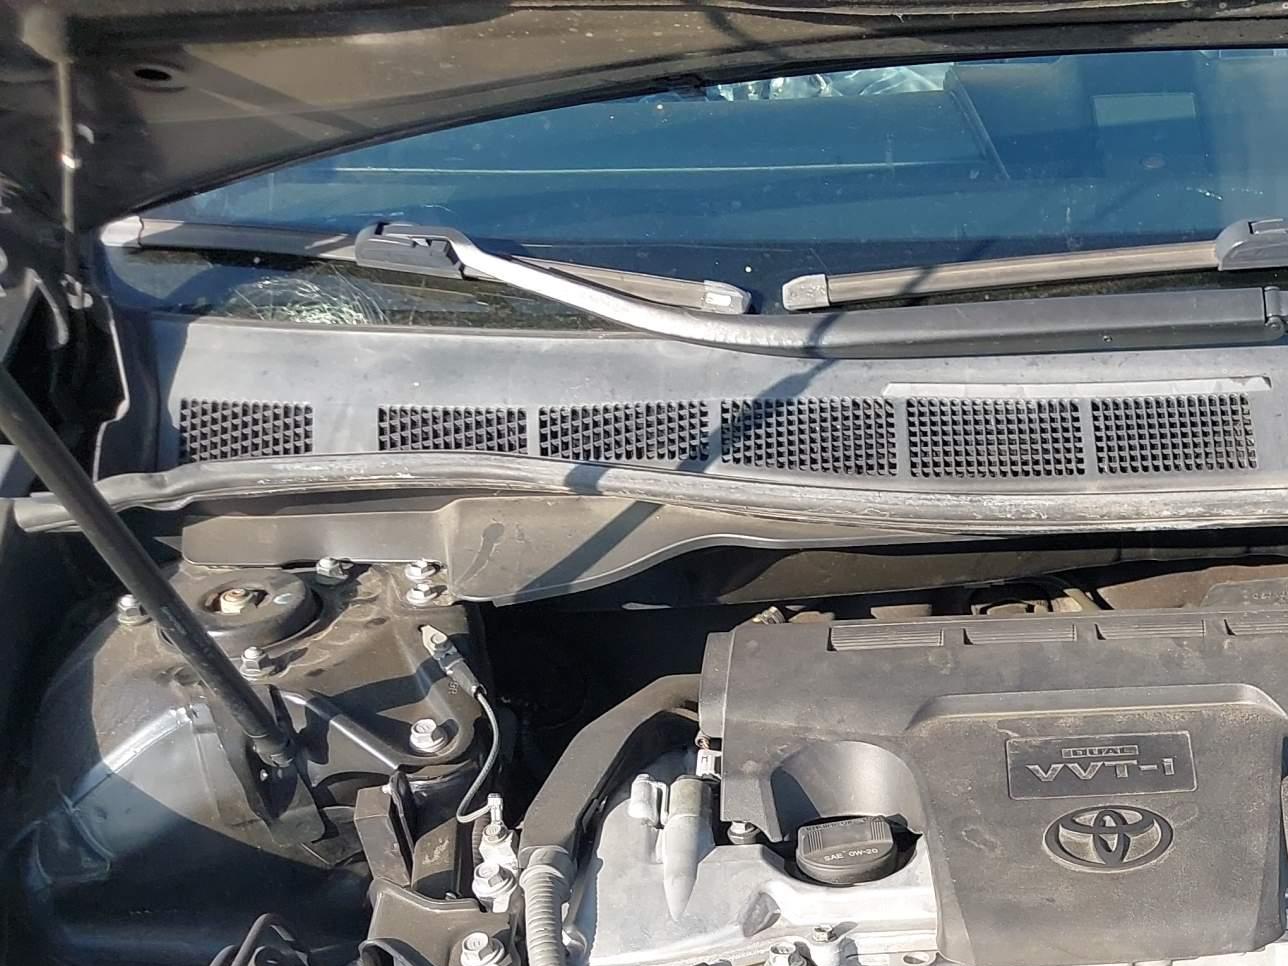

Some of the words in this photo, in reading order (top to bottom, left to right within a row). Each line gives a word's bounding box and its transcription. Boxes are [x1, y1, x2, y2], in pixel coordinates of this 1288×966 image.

[1071, 745, 1134, 757] DUAL
[823, 852, 845, 862] SAE
[848, 847, 879, 858] 0W-20
